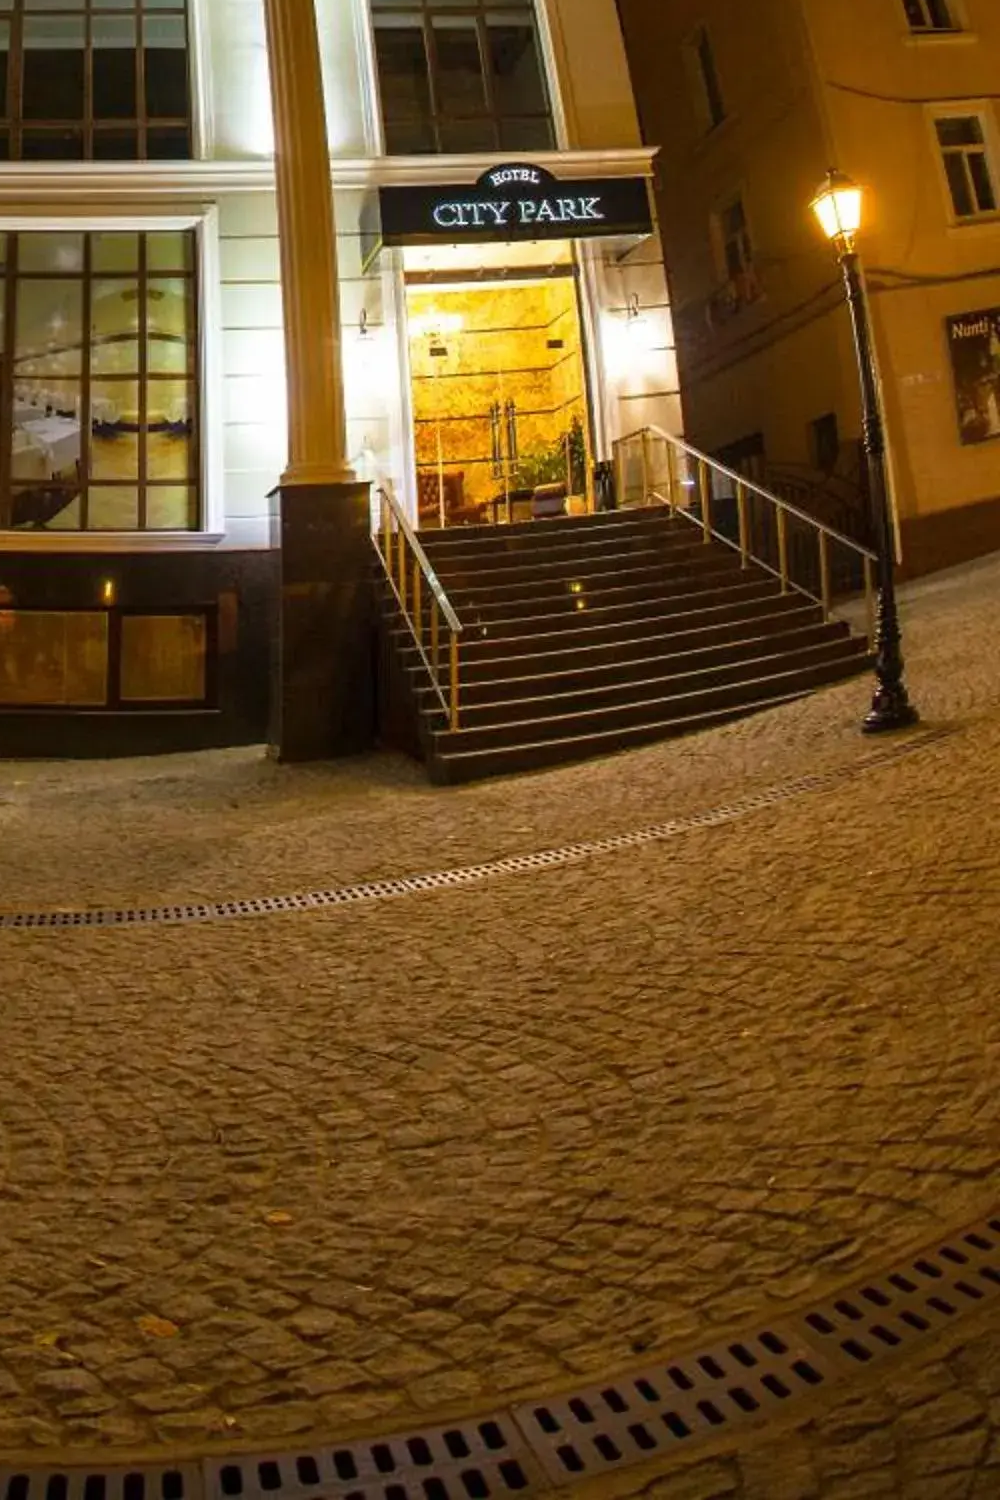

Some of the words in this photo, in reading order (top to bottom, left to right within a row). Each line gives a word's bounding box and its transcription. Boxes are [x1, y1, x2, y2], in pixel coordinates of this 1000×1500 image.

[489, 168, 541, 187] HOTEL
[432, 200, 512, 227] CITY
[517, 197, 605, 223] PARK
